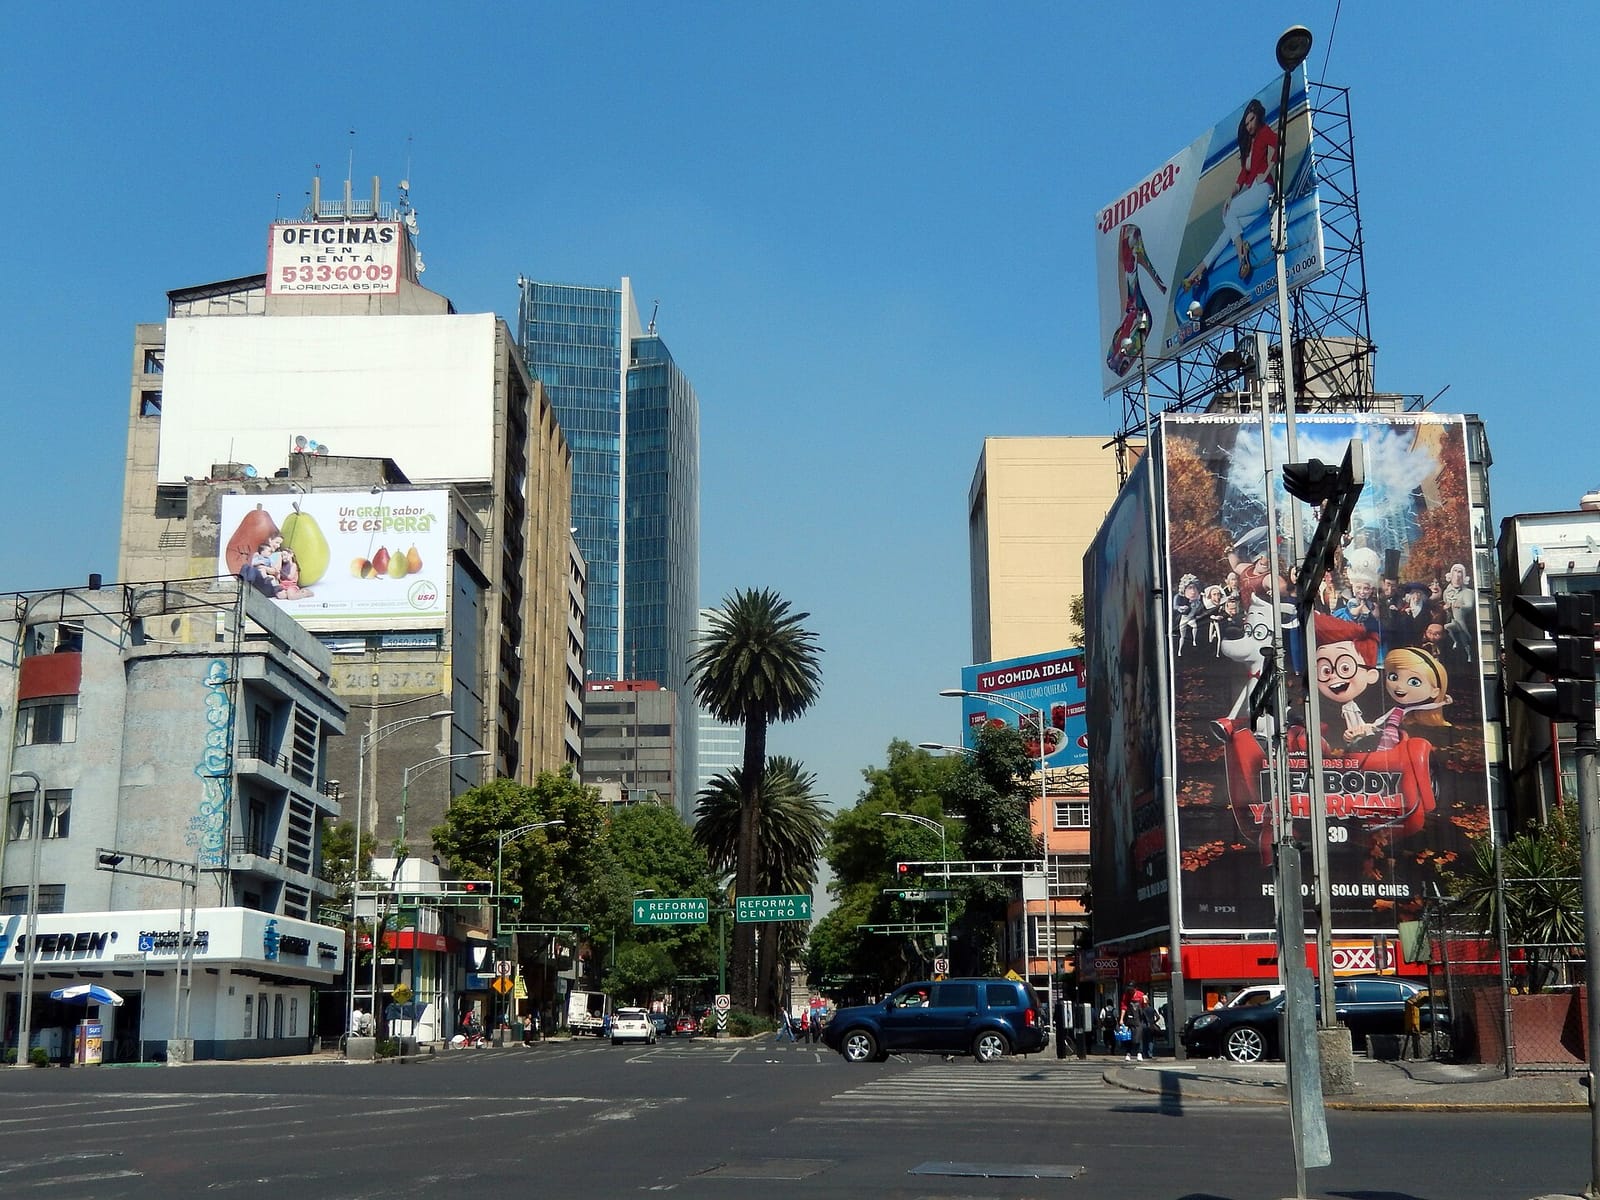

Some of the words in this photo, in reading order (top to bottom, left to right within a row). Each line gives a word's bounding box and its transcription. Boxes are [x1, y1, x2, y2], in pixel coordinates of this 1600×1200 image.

[282, 227, 394, 245] OFICINAS
[300, 255, 375, 263] RENTA
[280, 283, 350, 291] FLORENCIA
[1198, 415, 1260, 424] AVENTURA
[1294, 415, 1354, 425] DIVERTIDA
[339, 507, 355, 516] Un
[392, 506, 425, 516] sabor
[339, 518, 358, 532] te
[983, 677, 995, 688] TU
[998, 668, 1040, 685] COMIDA
[1043, 661, 1075, 677] IDEAL
[1345, 758, 1359, 768] DE
[1328, 827, 1348, 842] 3D
[1331, 884, 1359, 896] SOLO
[1362, 884, 1376, 896] EN
[1378, 884, 1410, 896] CINES
[739, 900, 795, 908] REFORMA
[650, 911, 705, 920] AUDITORIO
[740, 910, 795, 918] CENTRO
